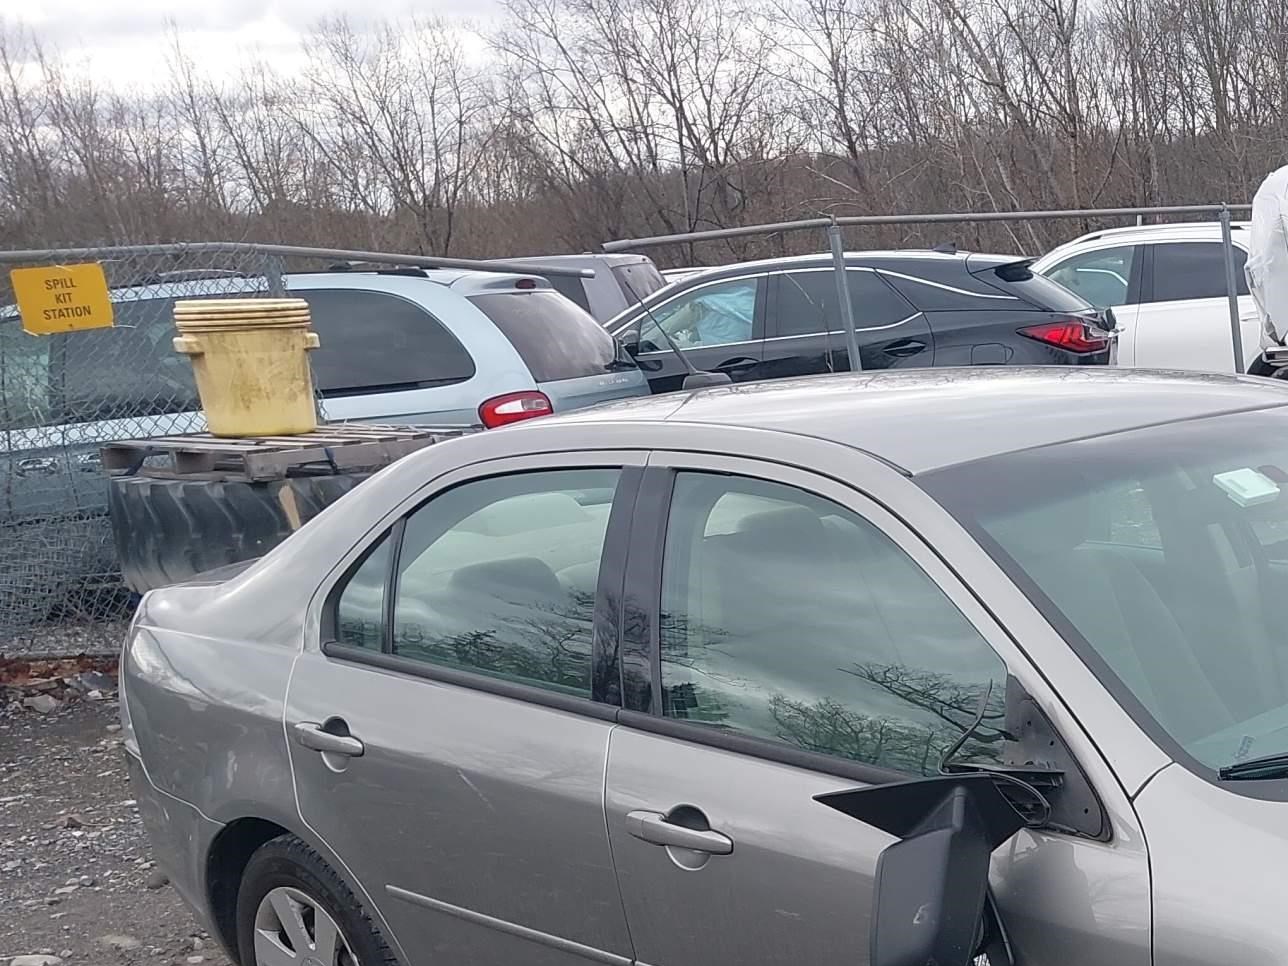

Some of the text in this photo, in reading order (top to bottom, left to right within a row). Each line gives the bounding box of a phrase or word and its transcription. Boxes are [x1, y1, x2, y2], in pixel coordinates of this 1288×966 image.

[44, 278, 76, 290] SPILL
[55, 292, 72, 304] KIT
[43, 305, 91, 320] STATION
